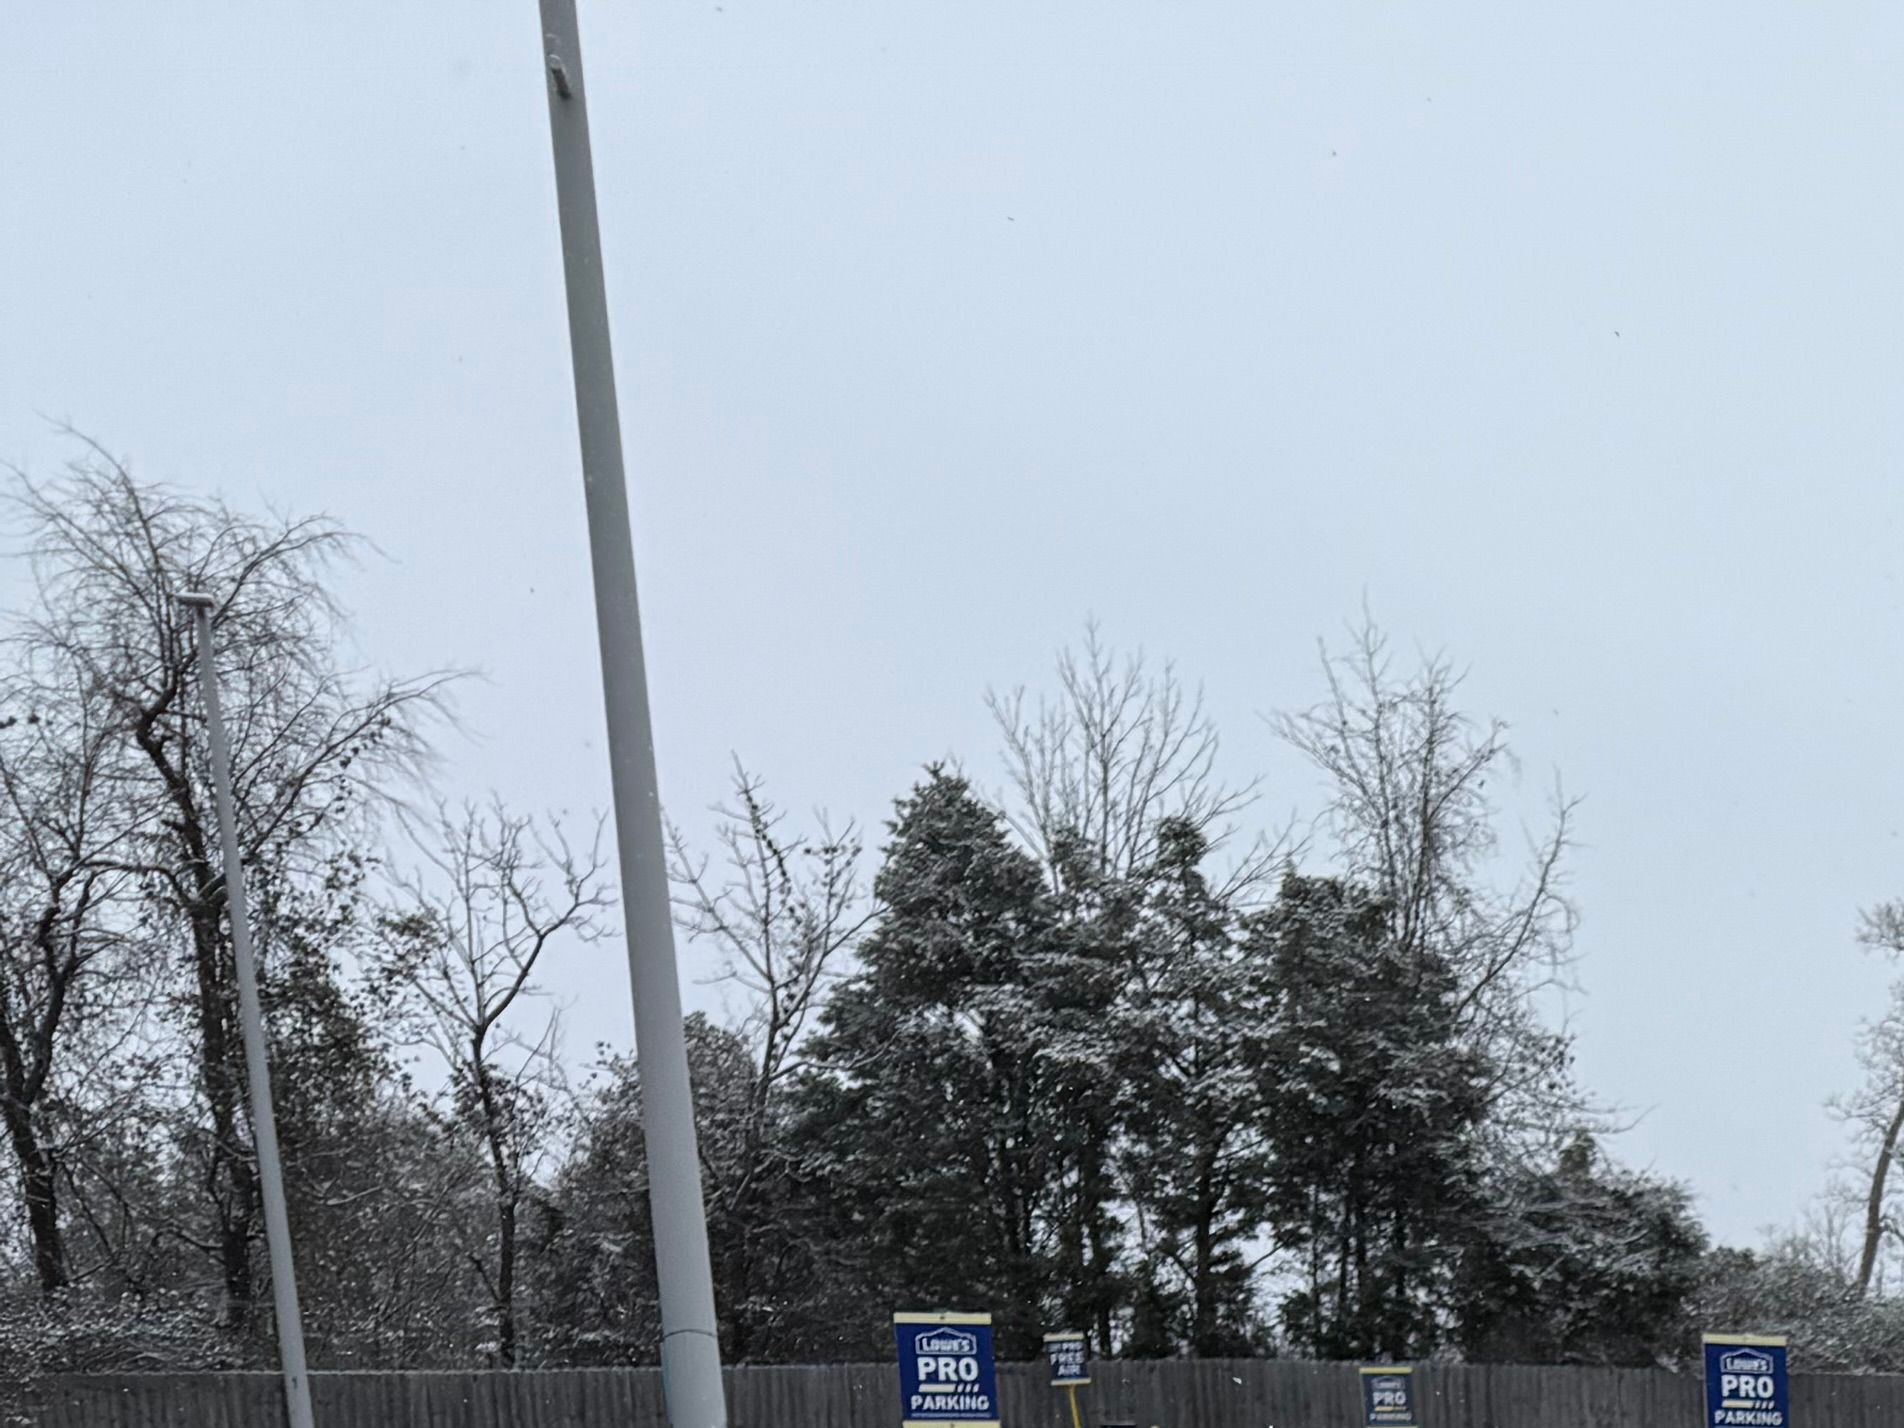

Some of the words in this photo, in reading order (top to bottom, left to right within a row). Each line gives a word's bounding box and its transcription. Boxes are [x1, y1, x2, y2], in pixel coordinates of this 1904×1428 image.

[917, 1356, 979, 1382] PRO
[1721, 1374, 1774, 1399] PRO
[910, 1395, 990, 1411] PARKING
[1372, 1391, 1407, 1406] PRO
[1714, 1409, 1783, 1426] PARKING
